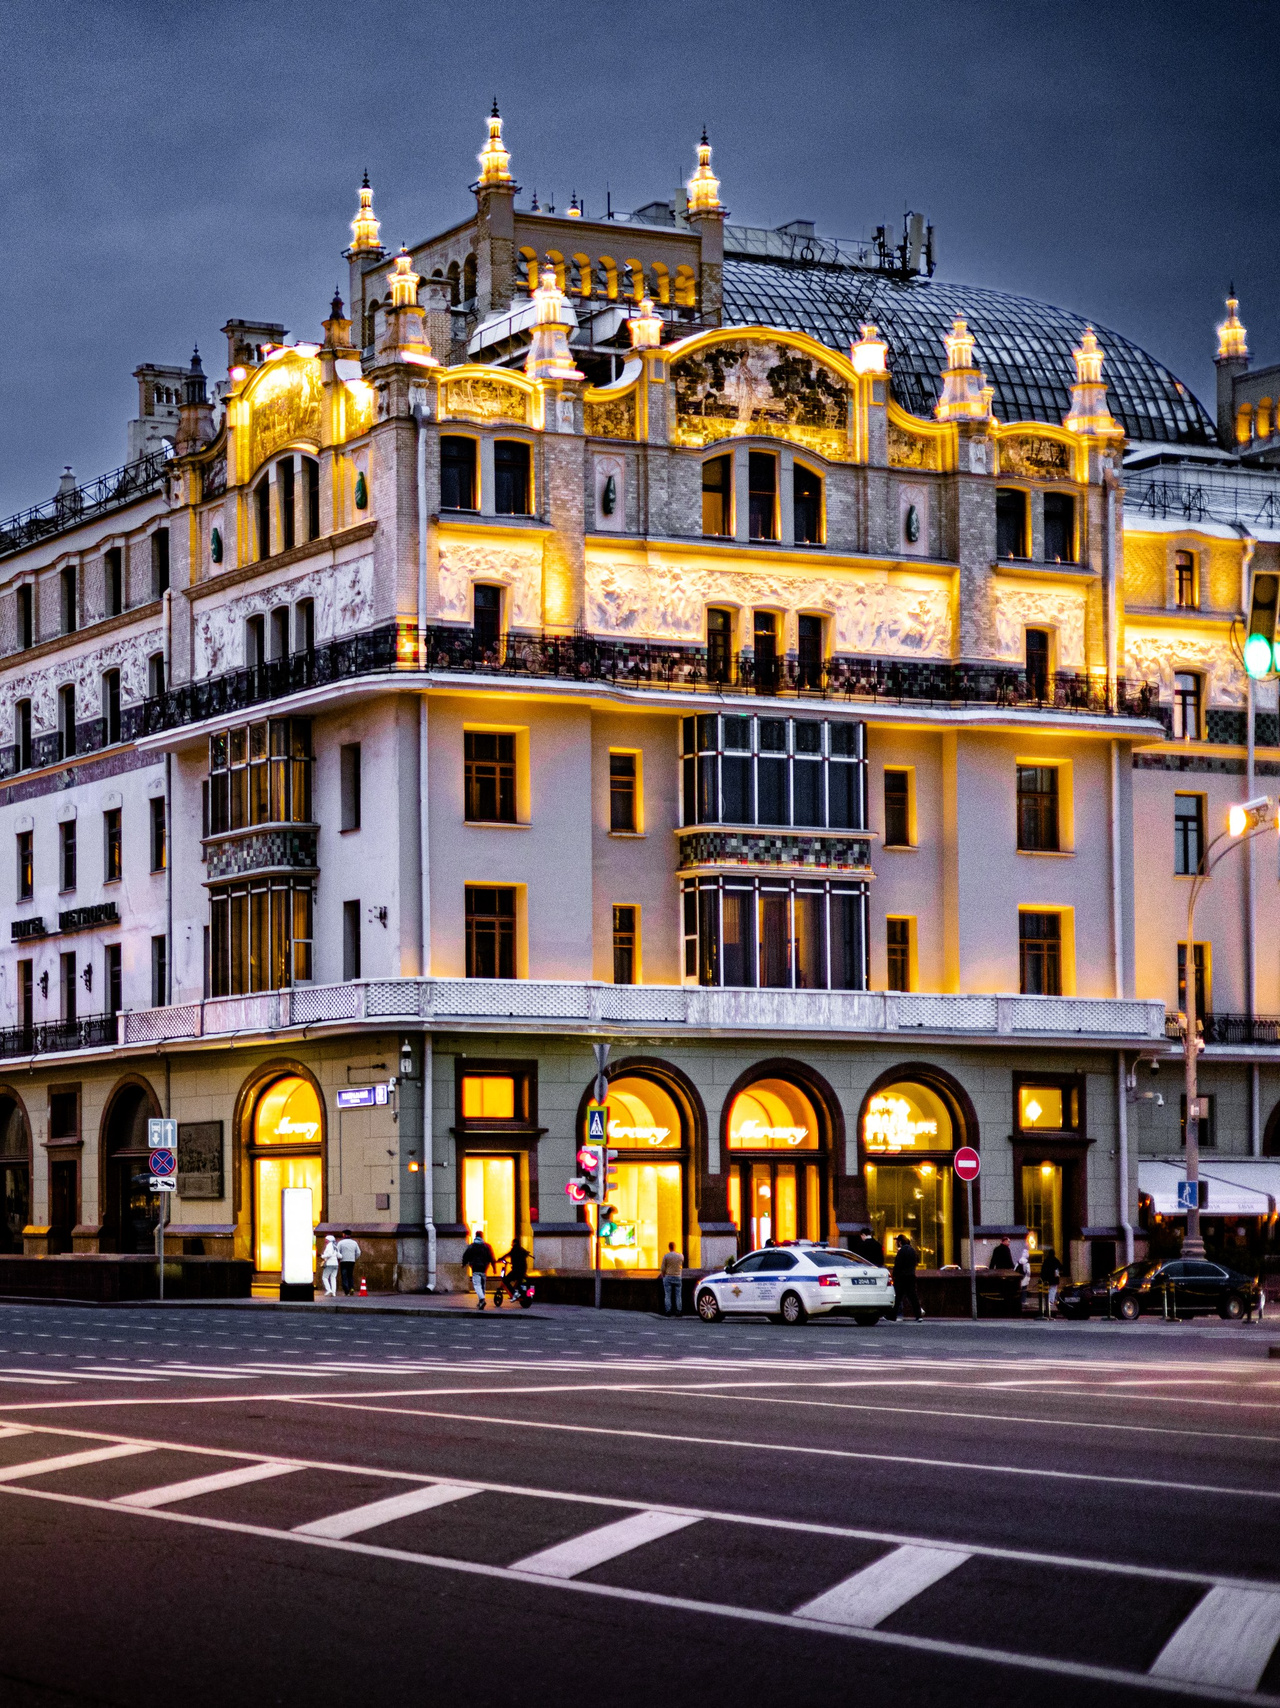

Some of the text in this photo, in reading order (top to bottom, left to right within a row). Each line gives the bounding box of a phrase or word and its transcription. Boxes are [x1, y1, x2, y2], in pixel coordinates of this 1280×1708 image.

[11, 902, 119, 938] HOTEL METROPOL
[731, 1119, 809, 1145] Mercury
